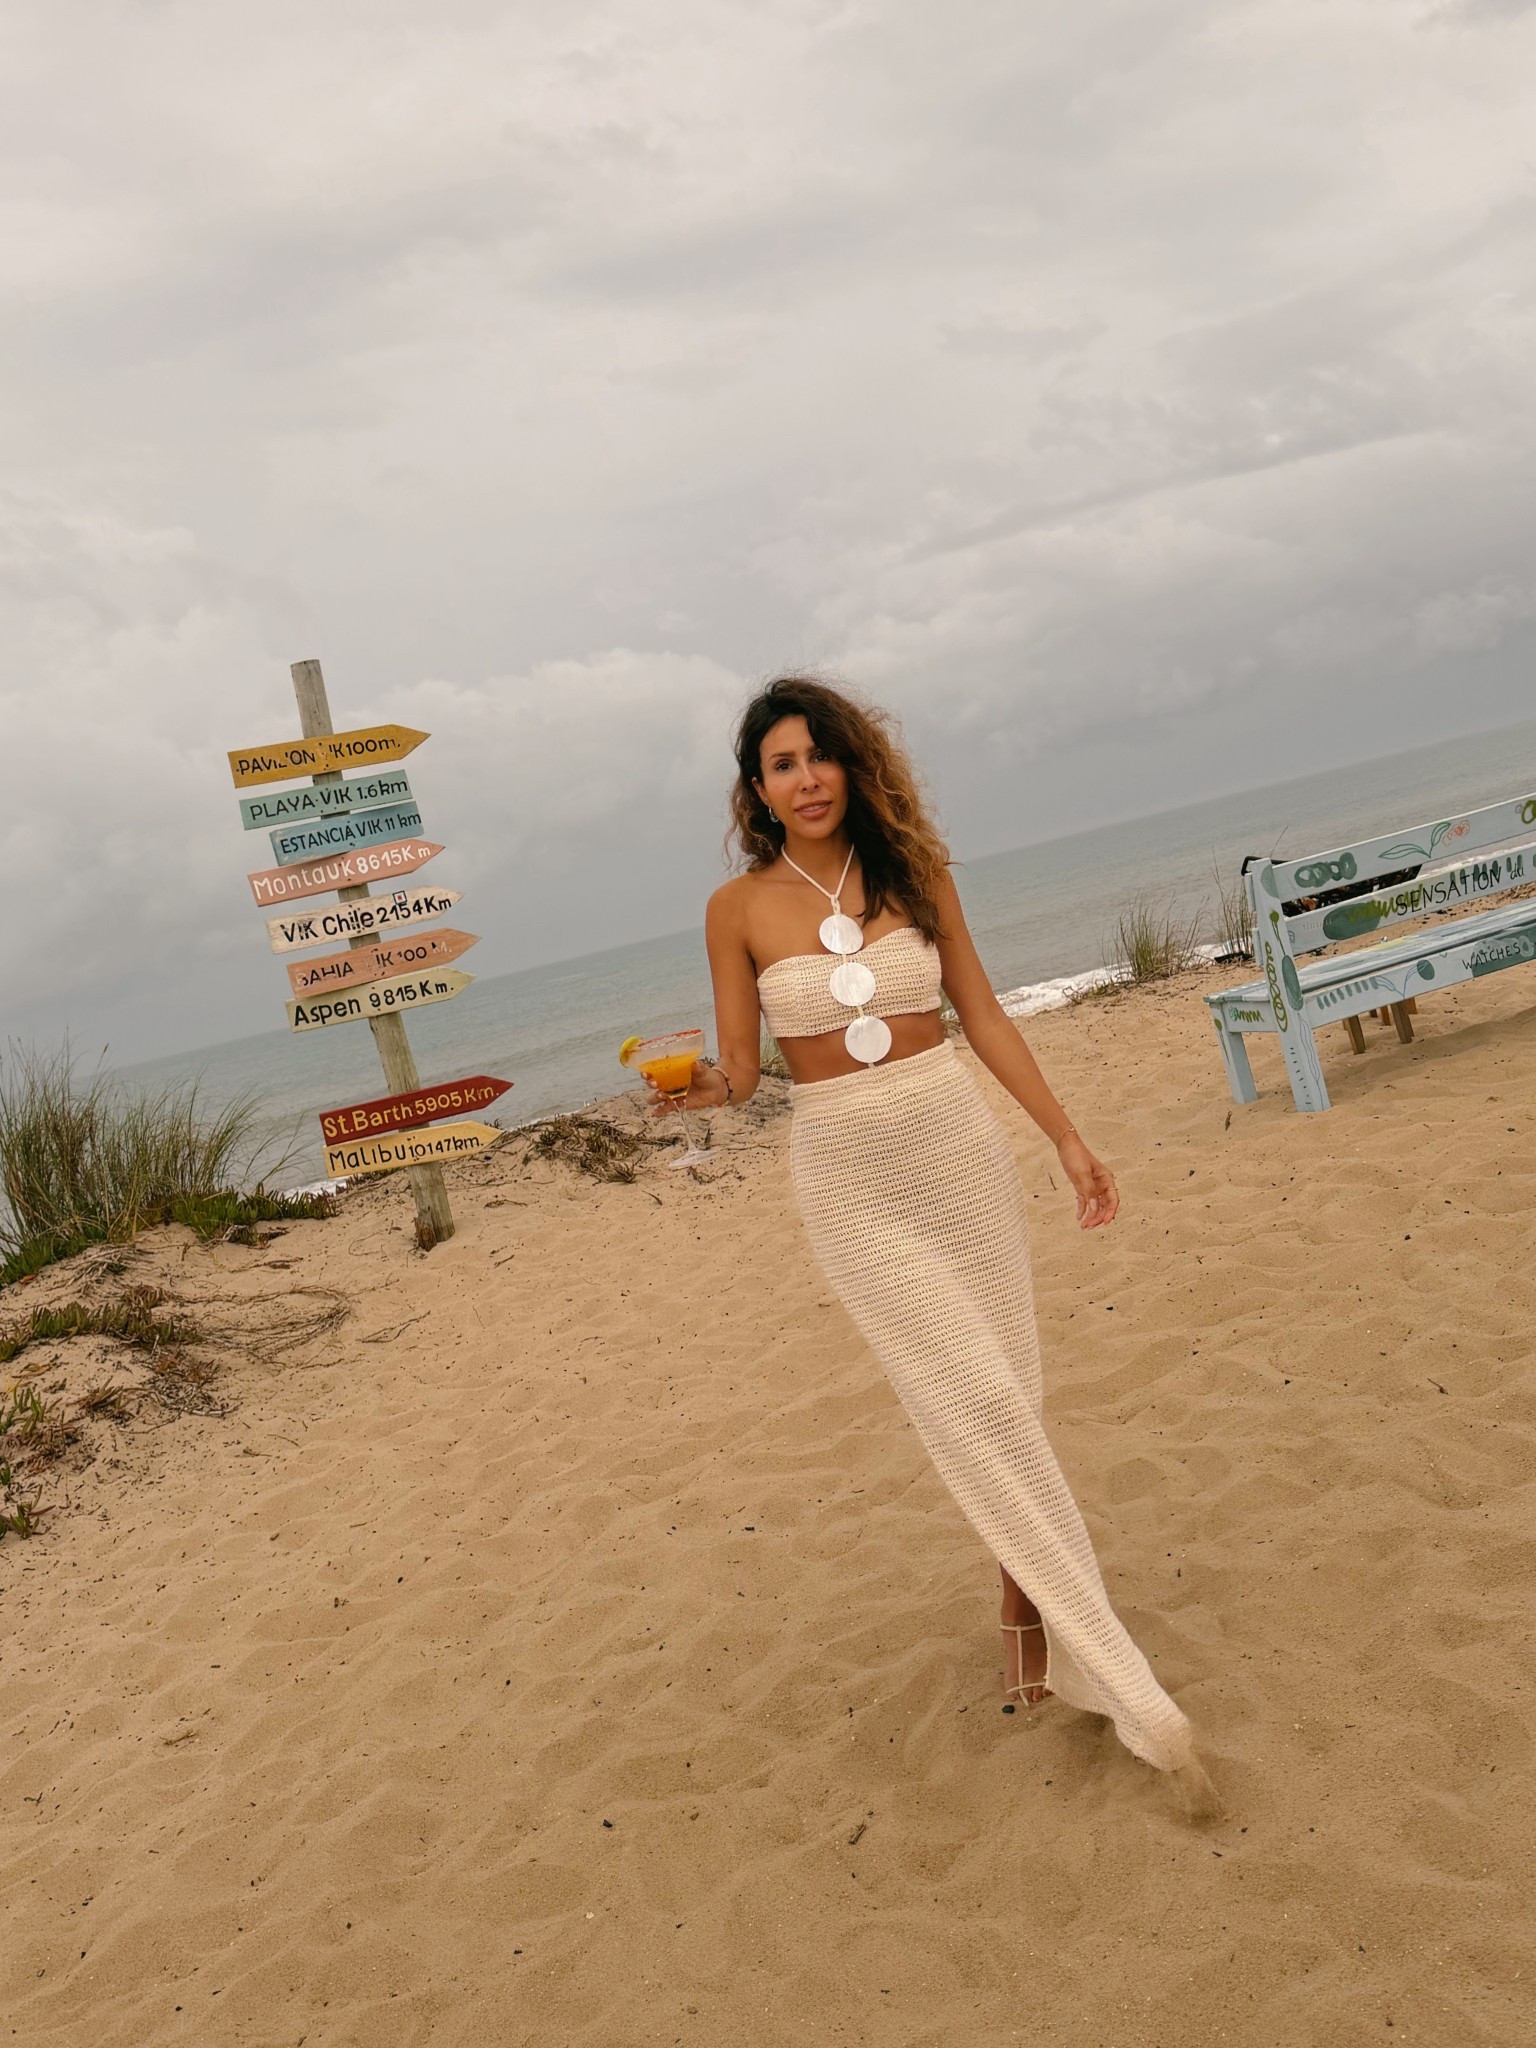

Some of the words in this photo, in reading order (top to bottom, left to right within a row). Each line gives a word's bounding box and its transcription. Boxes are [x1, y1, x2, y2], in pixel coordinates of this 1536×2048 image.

[249, 793, 316, 821] PLAYA
[320, 787, 353, 806] VIK
[280, 827, 356, 854] ESTANCIA
[355, 818, 383, 837] VIK
[1395, 865, 1502, 916] SENSATION
[280, 920, 319, 944] VIK
[322, 911, 374, 936] Chile
[1461, 942, 1521, 970] WATCHES
[294, 997, 361, 1026] Aspen
